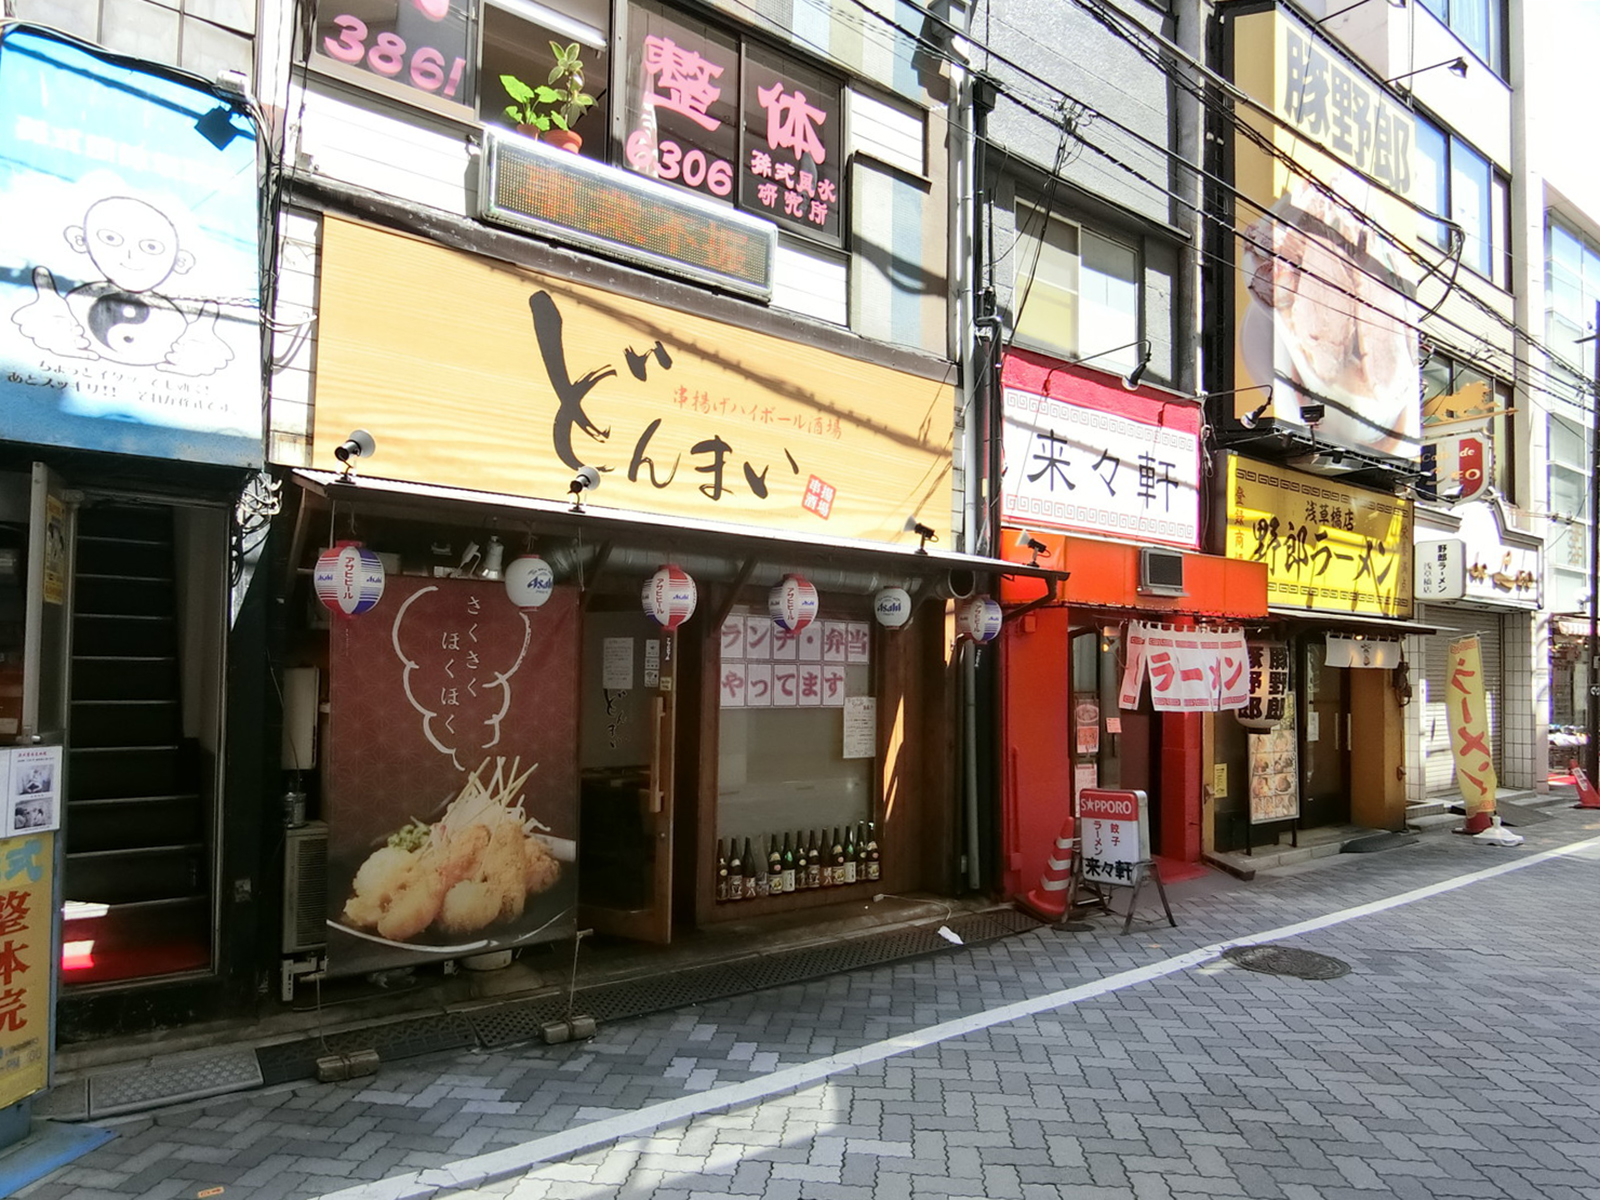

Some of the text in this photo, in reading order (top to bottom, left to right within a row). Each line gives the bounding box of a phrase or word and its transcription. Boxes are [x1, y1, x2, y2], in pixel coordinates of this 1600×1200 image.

[644, 34, 827, 164] 整体
[1284, 26, 1411, 195] 豚野郎
[626, 130, 733, 196] 6306
[757, 183, 828, 225] 研究所
[528, 290, 800, 501] どんまい
[673, 384, 843, 440] 串揚げハイボール酒場
[1027, 429, 1179, 513] 来々軒
[1234, 486, 1246, 560] 登録商
[1304, 500, 1354, 531] 浅草橋店
[1251, 515, 1395, 586] 野郎ラーメン
[1437, 544, 1447, 593] 野郎ラーメン
[343, 556, 355, 600] アサヒビール
[656, 578, 665, 614] アサヒビール
[786, 587, 795, 620] アサヒビール
[876, 602, 902, 612] Asahi
[465, 596, 482, 698] さくさく
[722, 623, 867, 656] ランチ・弁当
[440, 631, 461, 735] ほくほく
[722, 670, 844, 699] やってます
[1151, 652, 1243, 692] ラーメン
[1265, 646, 1288, 720] 豚野郎
[1093, 820, 1103, 856] ラーメン
[1110, 823, 1120, 847] 餃子
[0, 839, 43, 882] 式
[1085, 857, 1132, 881] 来々軒
